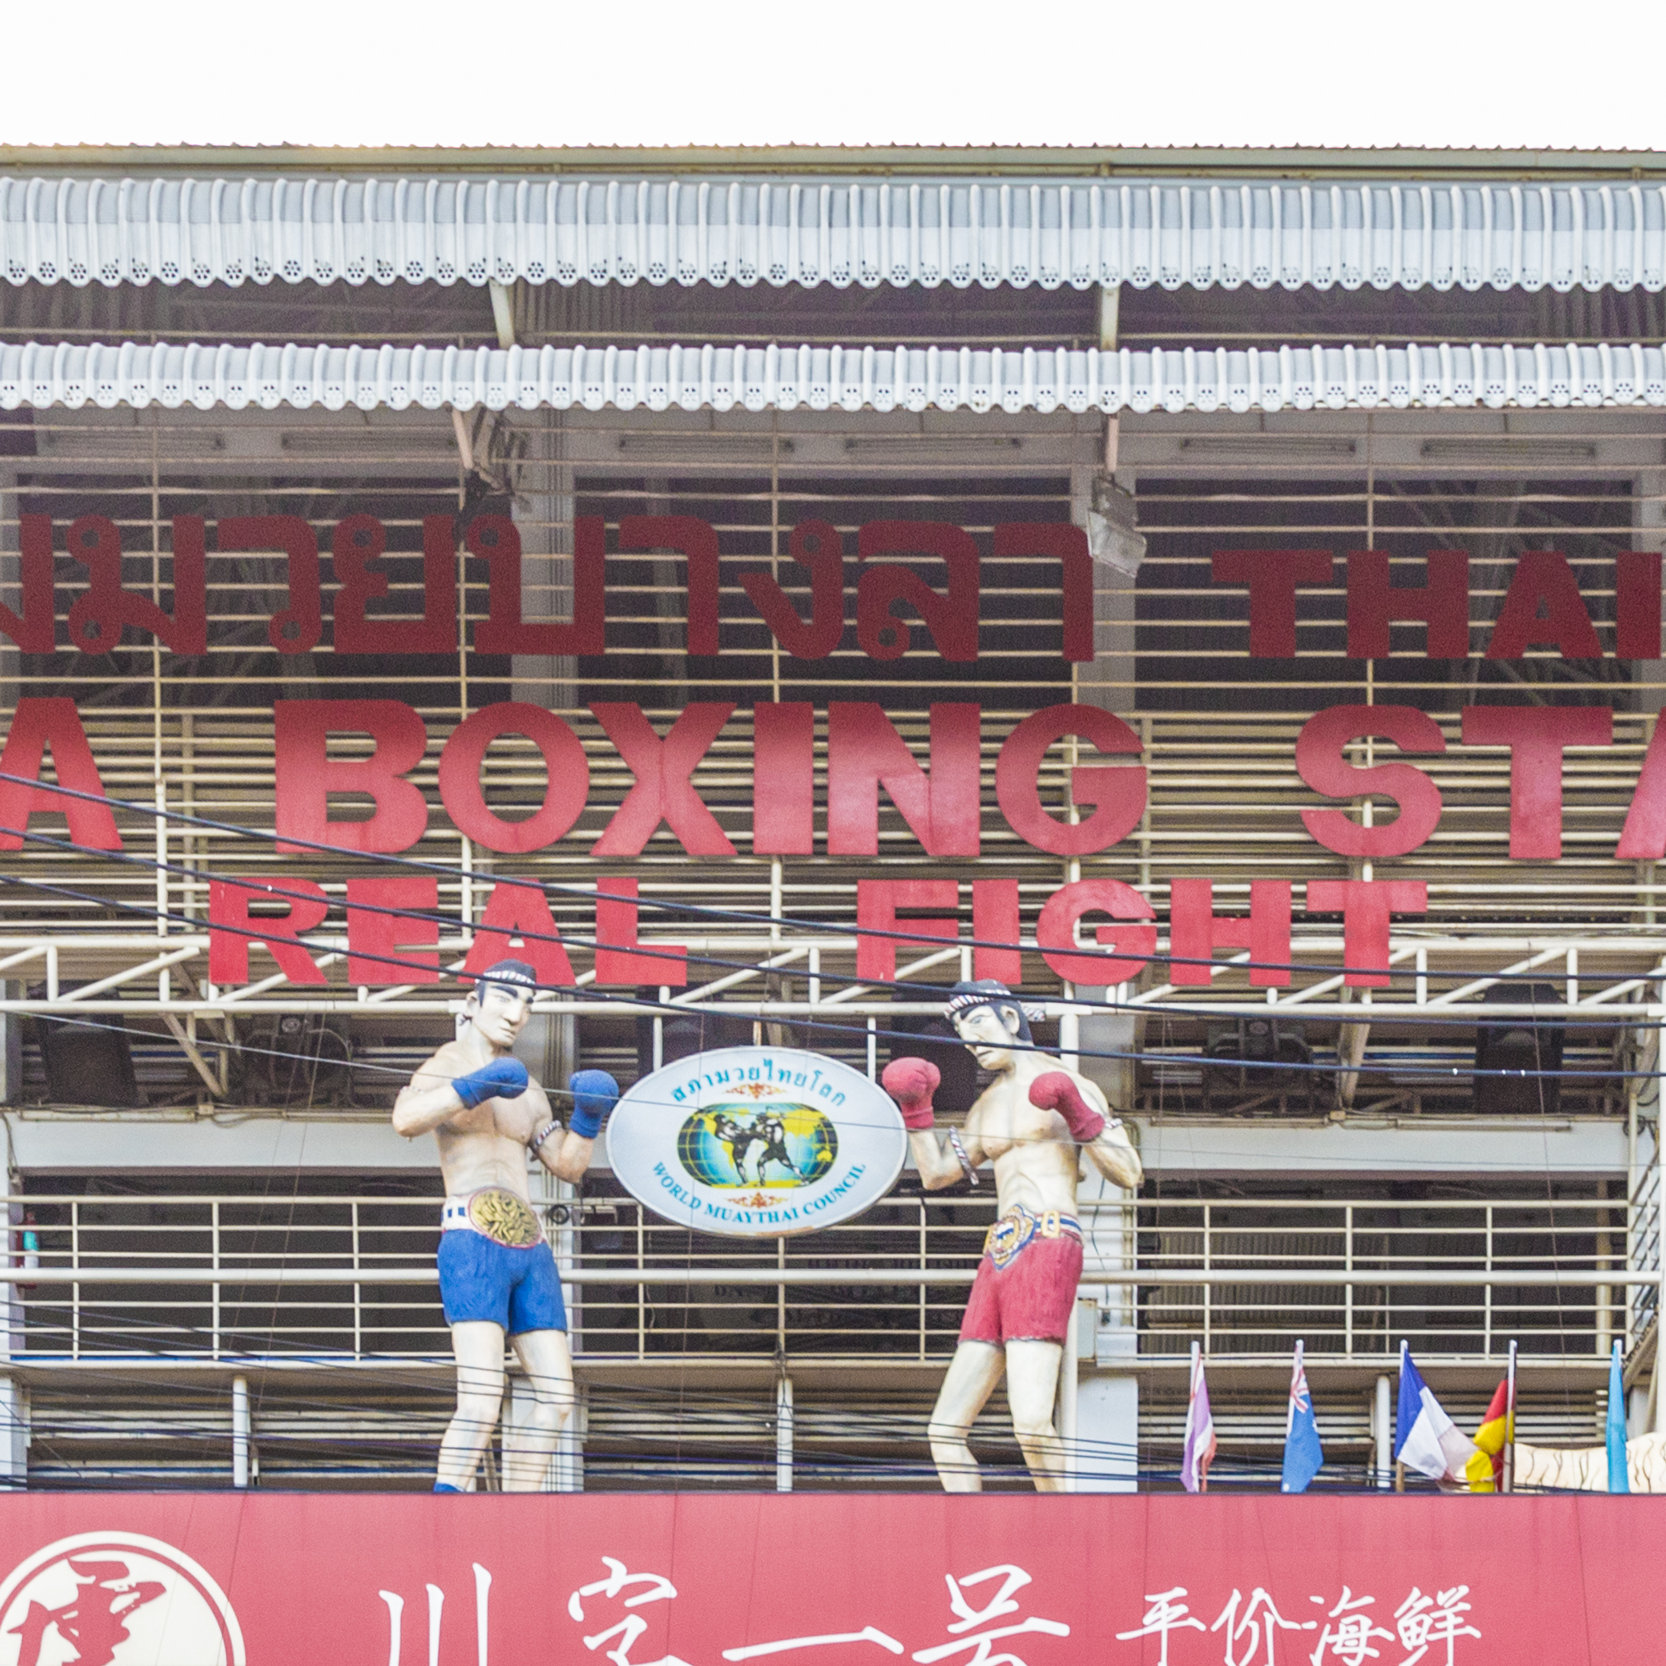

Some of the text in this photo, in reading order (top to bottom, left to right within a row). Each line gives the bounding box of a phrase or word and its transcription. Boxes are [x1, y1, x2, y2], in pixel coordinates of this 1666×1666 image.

[1211, 549, 1663, 660] THAI
[273, 699, 1148, 856] BOXING
[209, 878, 1427, 987] REAL FIGHT
[673, 1058, 847, 1107] สภามวยไทยโลก
[653, 1160, 867, 1225] WORLD MUAYTHAI COUNCIL
